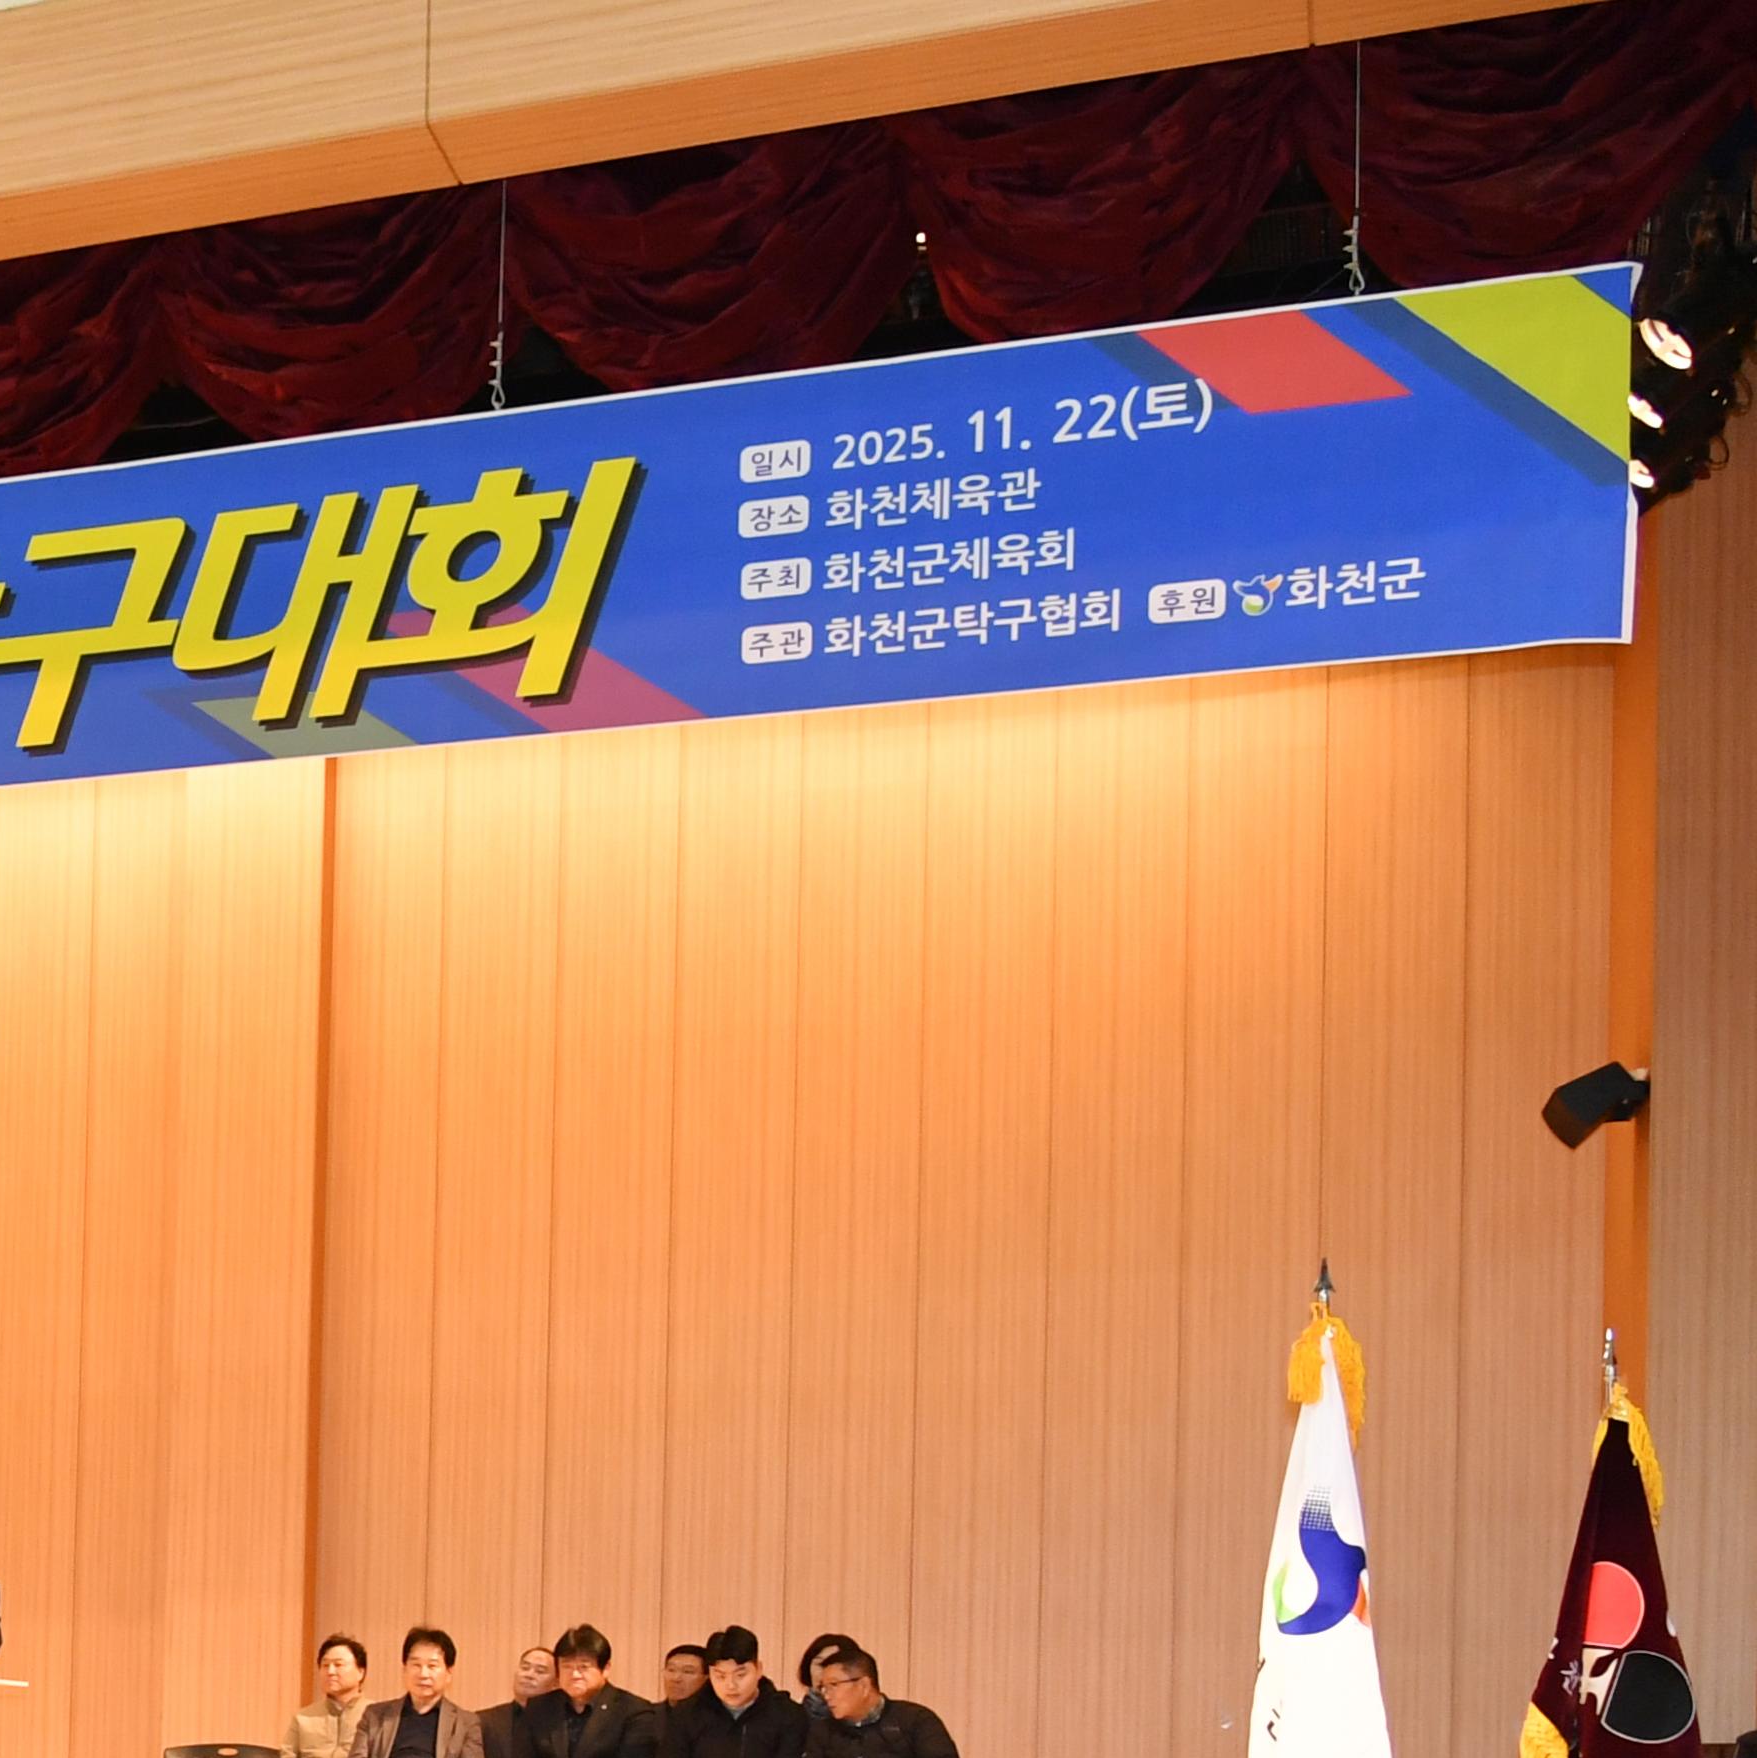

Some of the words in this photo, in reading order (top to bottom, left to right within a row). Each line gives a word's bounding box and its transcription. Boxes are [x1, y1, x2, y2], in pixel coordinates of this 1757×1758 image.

[748, 447, 805, 478] 일시
[831, 427, 946, 472] 2025.
[967, 409, 1032, 453] 11.
[1054, 377, 1215, 446] 22(토)
[748, 502, 805, 533] 장소
[826, 469, 1041, 531] 화천체육관
[747, 562, 805, 595] 주최
[822, 528, 1078, 598] 화천군체육회
[748, 627, 806, 658] 주관
[823, 589, 1123, 659] 화천군탁구협회
[1157, 583, 1218, 618] 후원
[1285, 557, 1427, 611] 화천군
